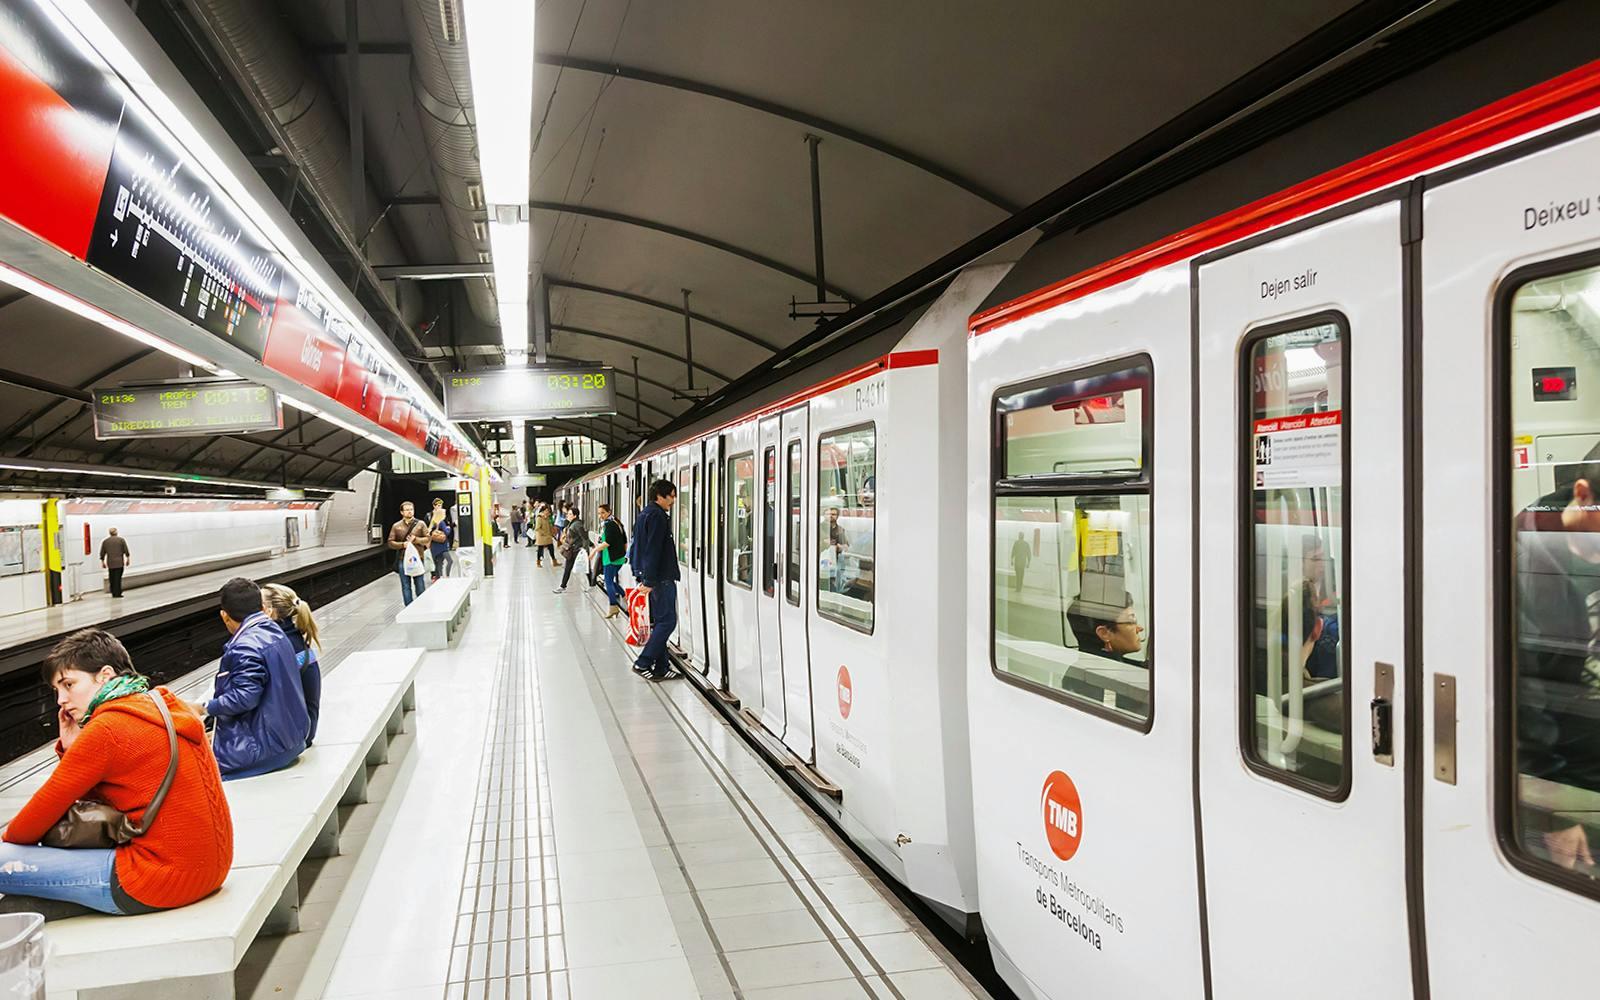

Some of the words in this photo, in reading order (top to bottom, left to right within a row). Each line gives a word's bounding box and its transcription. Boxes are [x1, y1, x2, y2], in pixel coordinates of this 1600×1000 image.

[1524, 198, 1590, 230] Deixeu
[1261, 278, 1290, 300] Dejen
[1294, 269, 1317, 290] salir
[547, 373, 606, 390] 03:20
[102, 394, 136, 404] 21:36
[1048, 798, 1078, 838] TMB
[1016, 841, 1059, 887] Transports
[1061, 871, 1124, 934] Metropolitans
[1036, 886, 1048, 908] de
[1049, 894, 1102, 951] Barcelona
